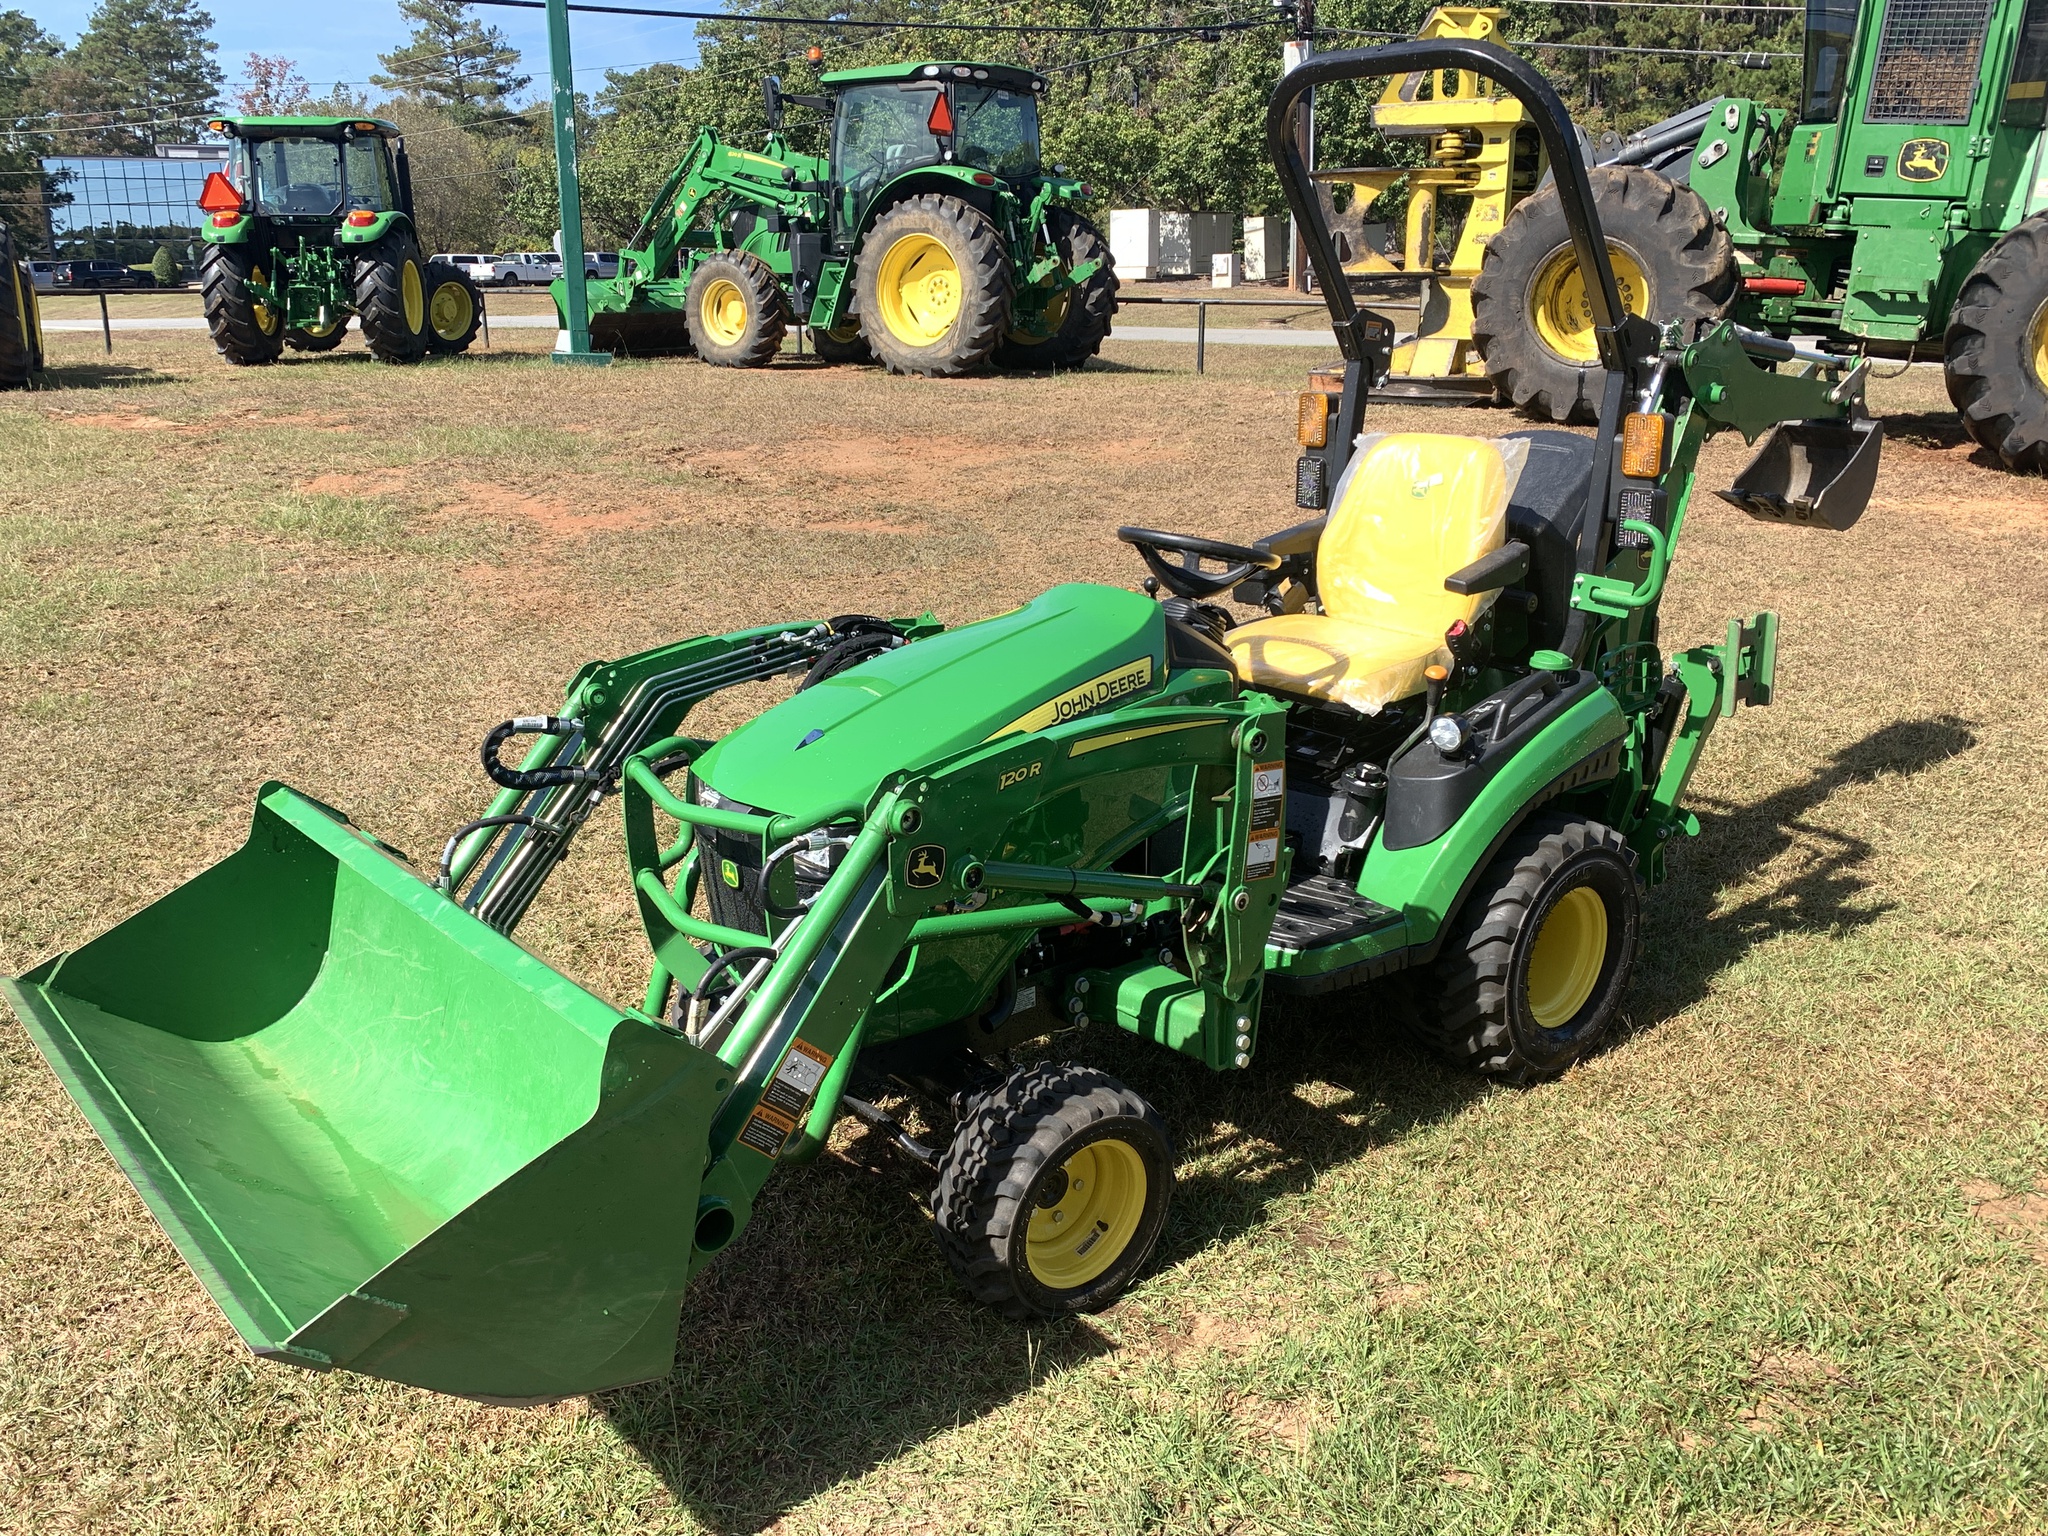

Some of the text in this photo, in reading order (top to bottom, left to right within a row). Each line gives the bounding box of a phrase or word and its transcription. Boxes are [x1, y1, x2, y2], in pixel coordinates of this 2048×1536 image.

[1052, 669, 1146, 723] JOHN DEERE
[802, 1047, 828, 1064] WARNING
[765, 1112, 790, 1130] WARNING
